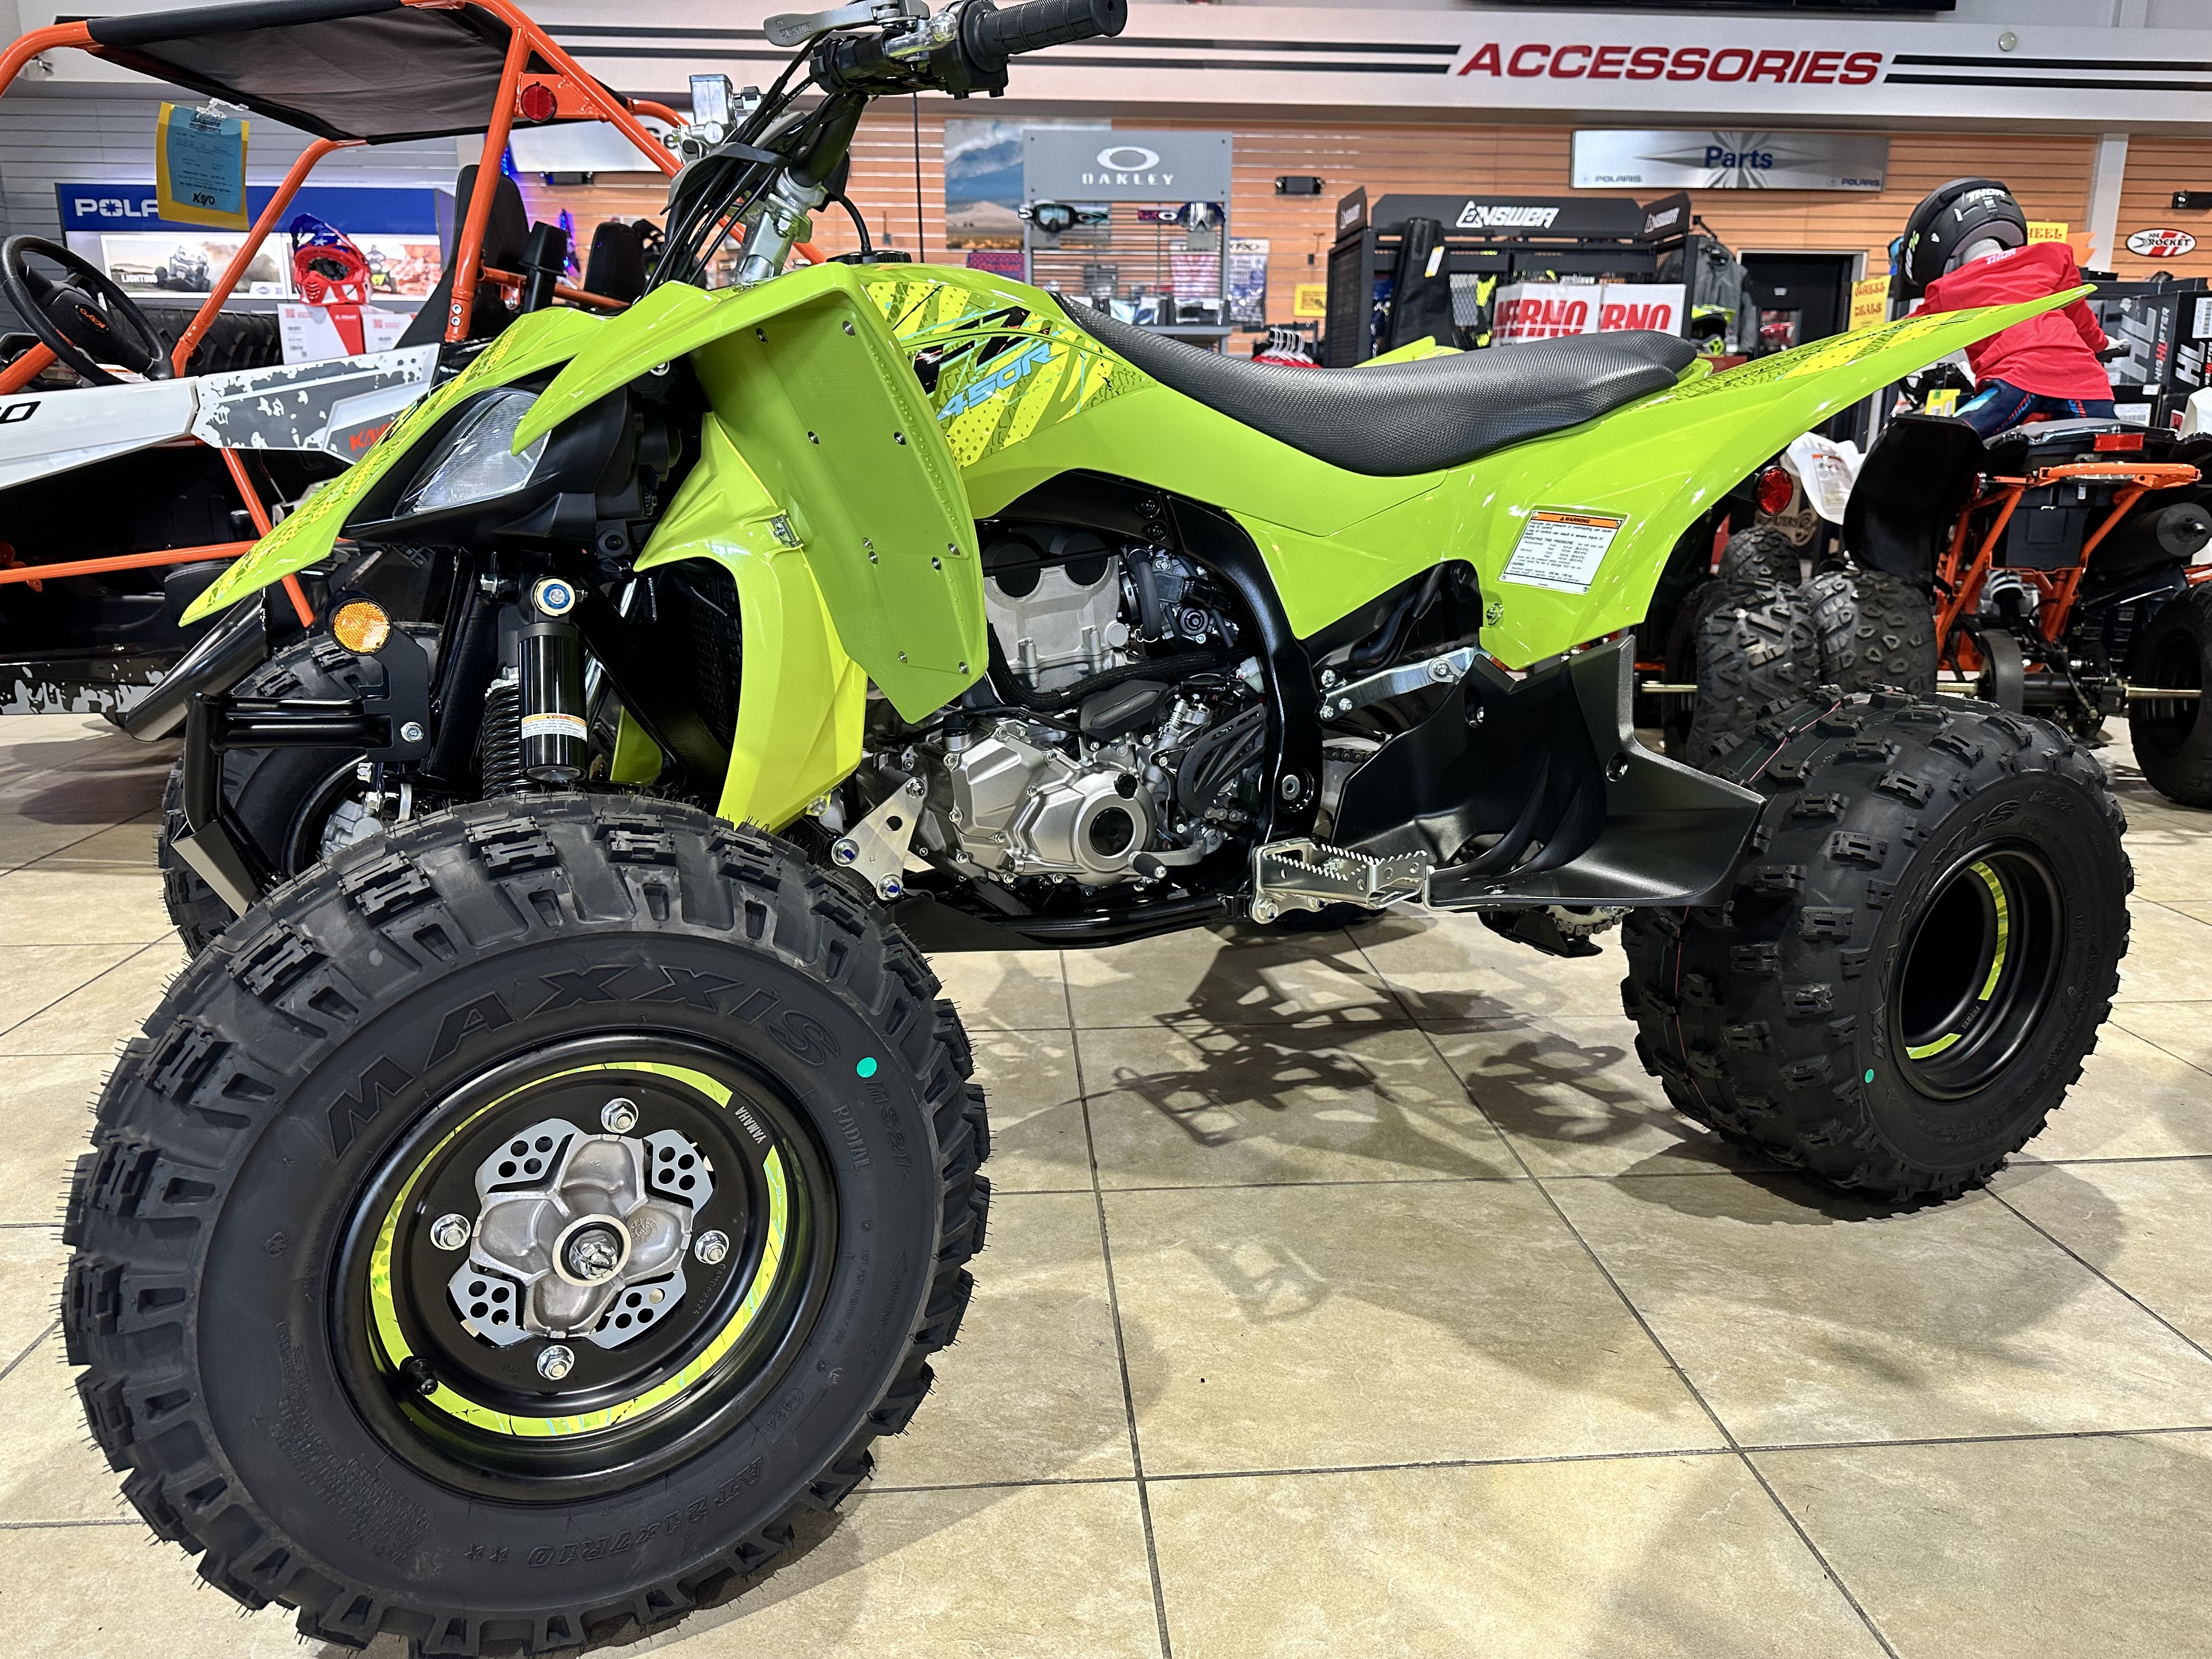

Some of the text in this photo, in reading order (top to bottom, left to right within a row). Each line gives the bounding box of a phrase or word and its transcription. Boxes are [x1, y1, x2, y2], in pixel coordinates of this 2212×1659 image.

[779, 21, 812, 38] PARKING
[1458, 43, 1883, 84] ACCESSORIES
[1705, 146, 1773, 169] Parts
[1082, 173, 1175, 187] OAKLEY
[1595, 174, 1643, 183] POLARIS
[1841, 178, 1880, 187] POLARIS
[1966, 188, 2006, 202] THOR
[75, 199, 159, 217] POLA
[1455, 200, 1560, 229] ANSWER
[1985, 248, 2017, 265] THOR
[121, 274, 158, 284] LIGHTING
[2175, 341, 2206, 387] HL
[1961, 1005, 1982, 1030] YAMAHA
[326, 964, 838, 1161] MAXXIS
[733, 1105, 764, 1144] YAMAHA
[864, 1074, 914, 1169] MS21
[832, 1103, 872, 1170] RADIAL
[840, 1287, 862, 1327] HIGHWAY
[765, 1392, 802, 1430] 1424
